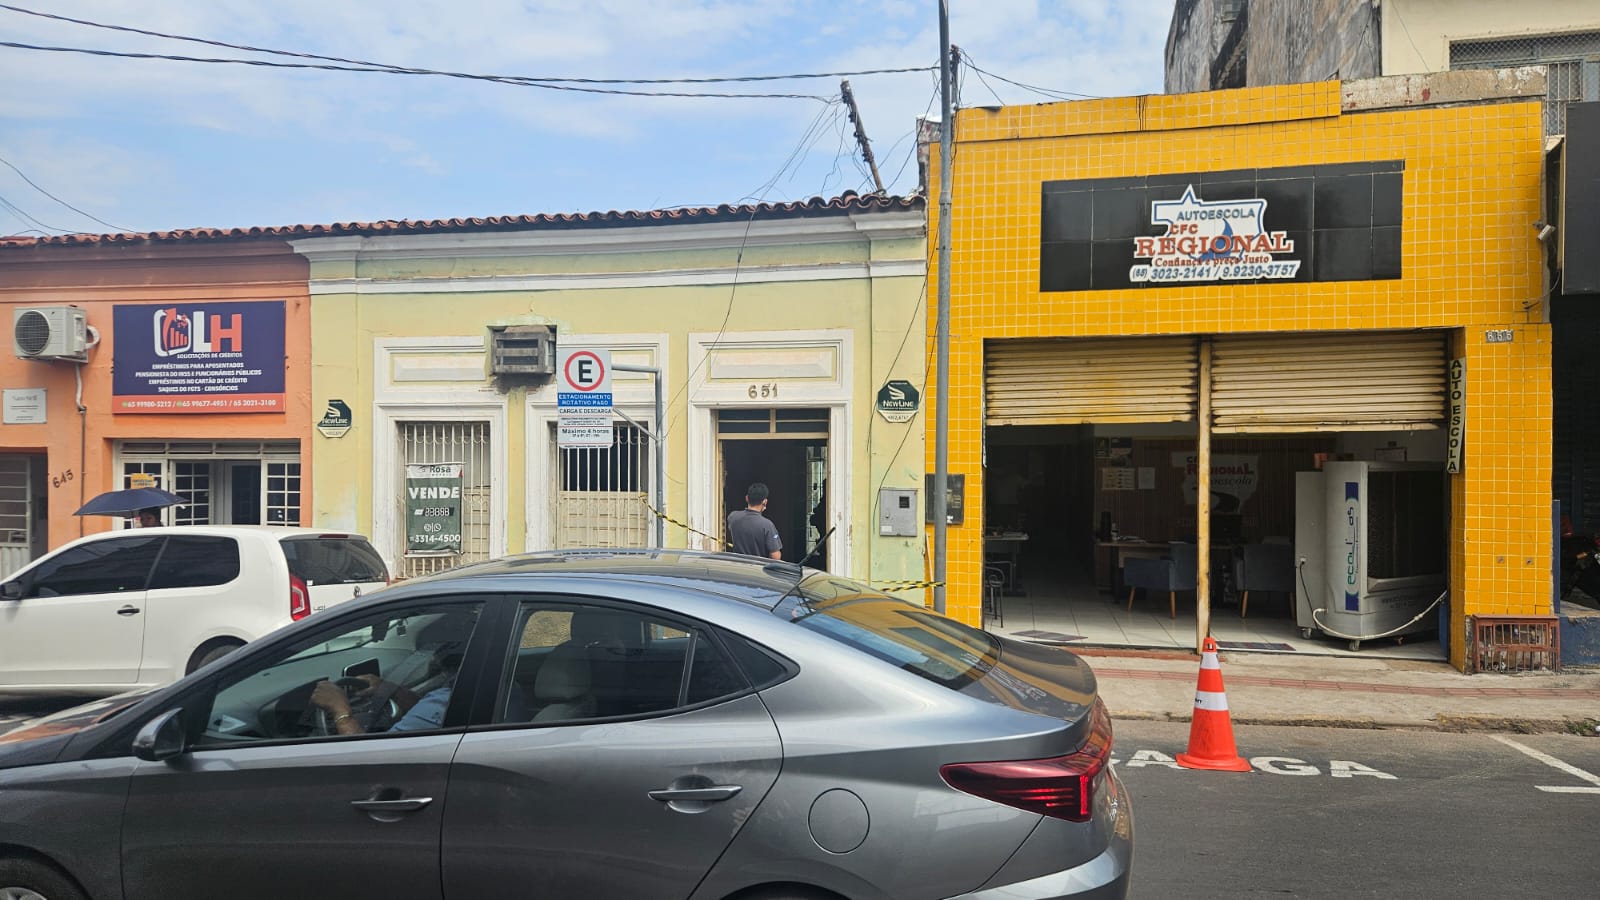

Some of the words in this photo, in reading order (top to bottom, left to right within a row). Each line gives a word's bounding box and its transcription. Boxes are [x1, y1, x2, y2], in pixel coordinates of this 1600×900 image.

[1177, 208, 1255, 221] AUTOESCOLA
[1170, 223, 1198, 235] CFC
[1136, 234, 1292, 257] REGIONAL
[1243, 256, 1269, 265] Justo
[1151, 267, 1211, 280] 3023-2141
[1223, 263, 1296, 278] 9.9230-3757
[578, 360, 593, 383] E
[1451, 359, 1462, 400] AUTO
[748, 384, 778, 399] 651
[1447, 405, 1462, 472] ESCOLA
[52, 469, 74, 489] 645
[408, 487, 460, 500] VENDE
